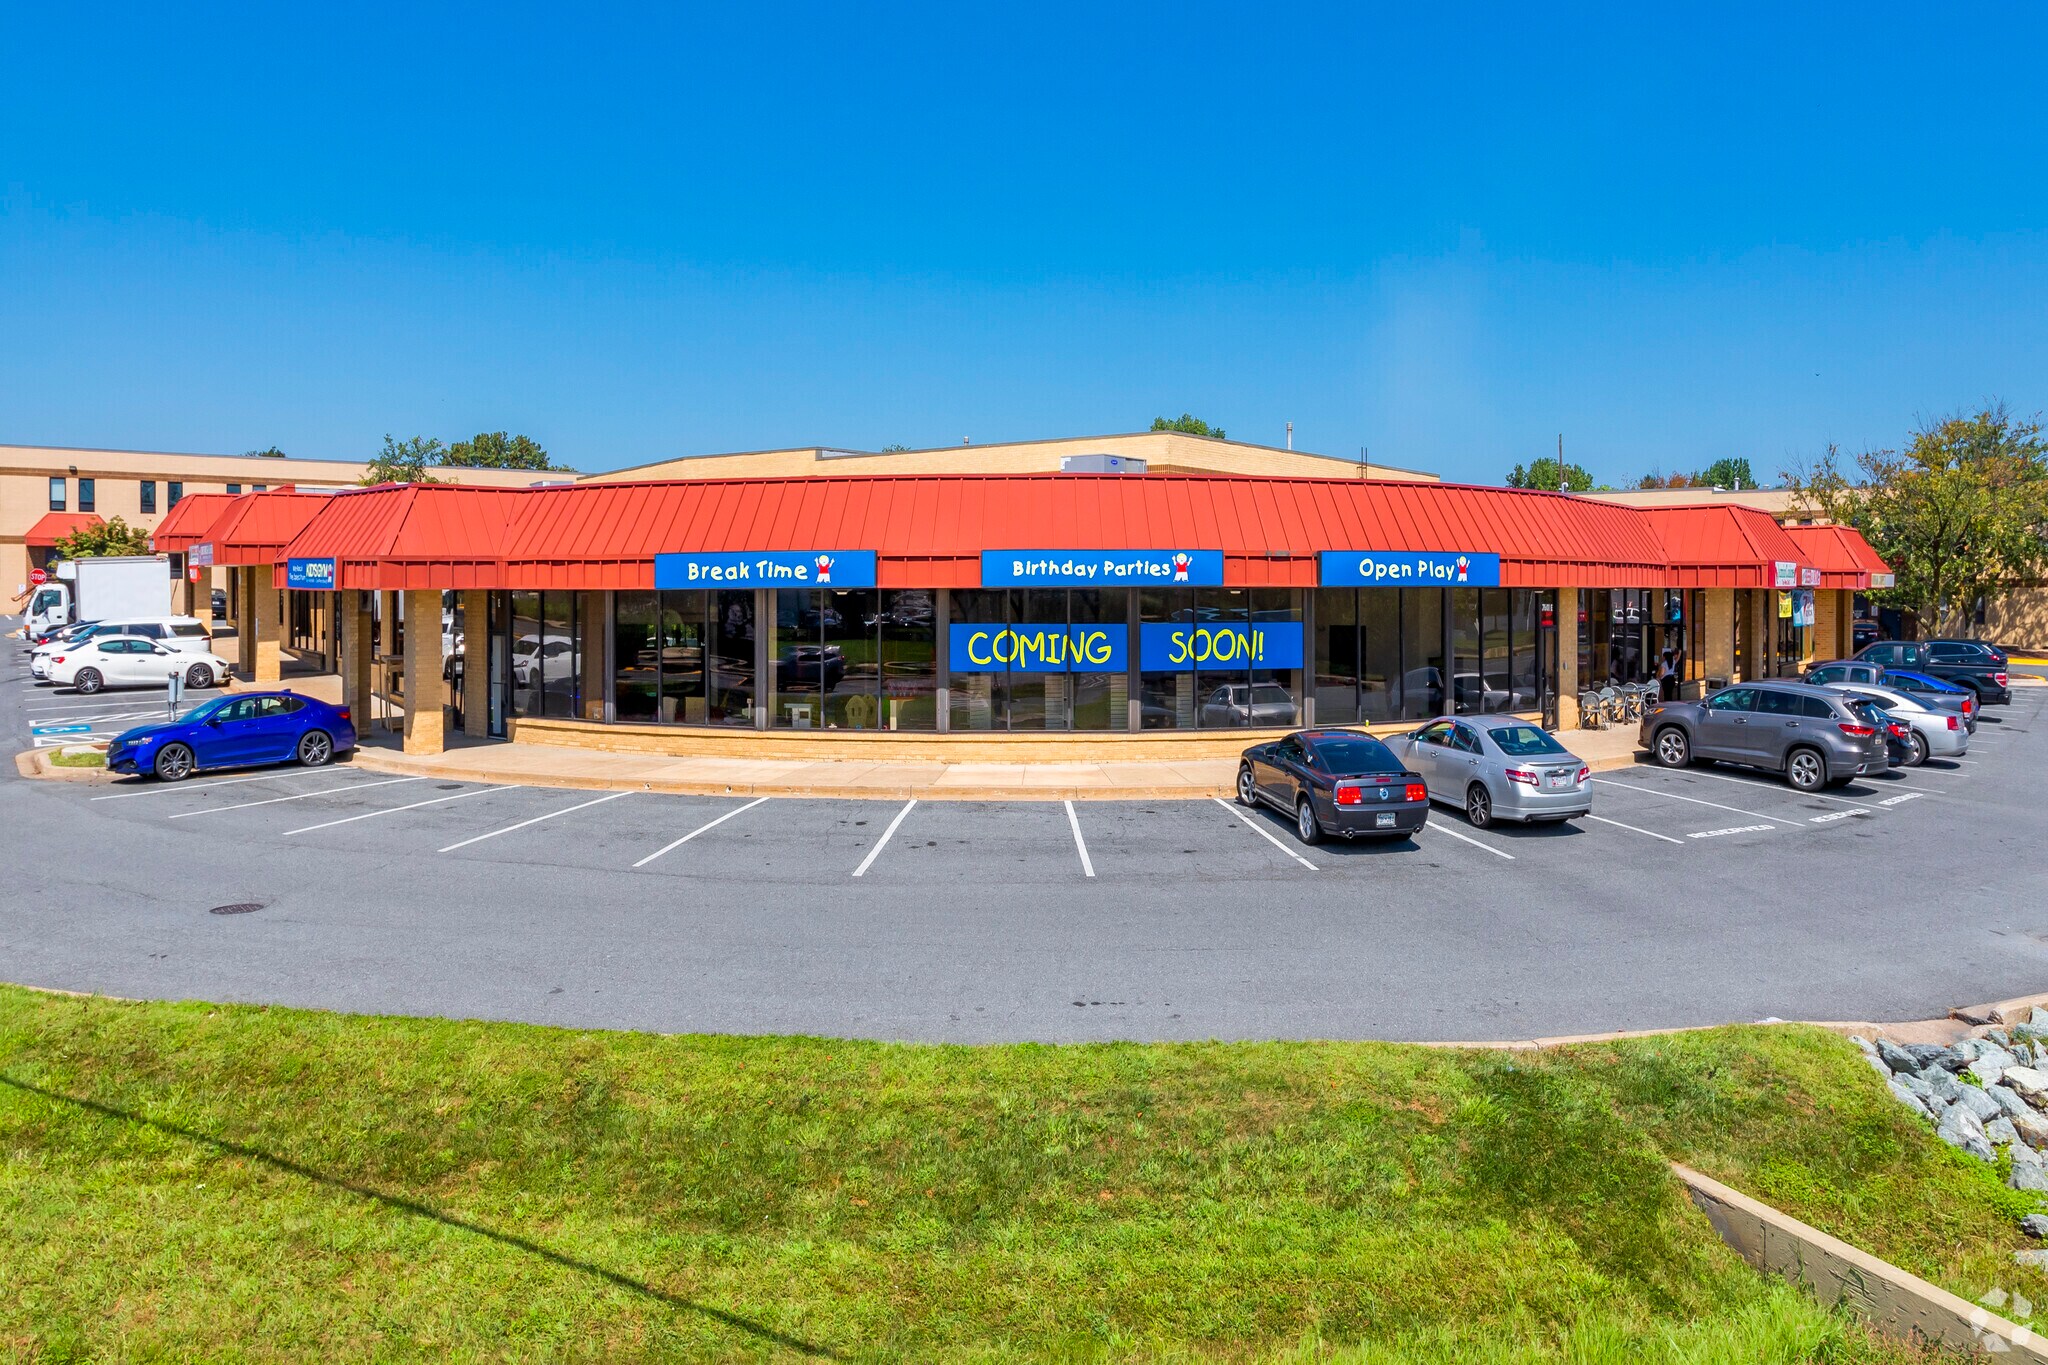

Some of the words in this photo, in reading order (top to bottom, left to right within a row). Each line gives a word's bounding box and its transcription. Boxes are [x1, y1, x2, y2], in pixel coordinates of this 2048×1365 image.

[688, 561, 750, 580] Break
[756, 560, 808, 580] Time
[1012, 560, 1098, 579] Birthday
[1103, 559, 1171, 576] Parties
[1359, 558, 1412, 581] Open
[1418, 560, 1454, 581] Play
[968, 630, 1112, 668] COMING
[1169, 629, 1264, 663] SOON!
